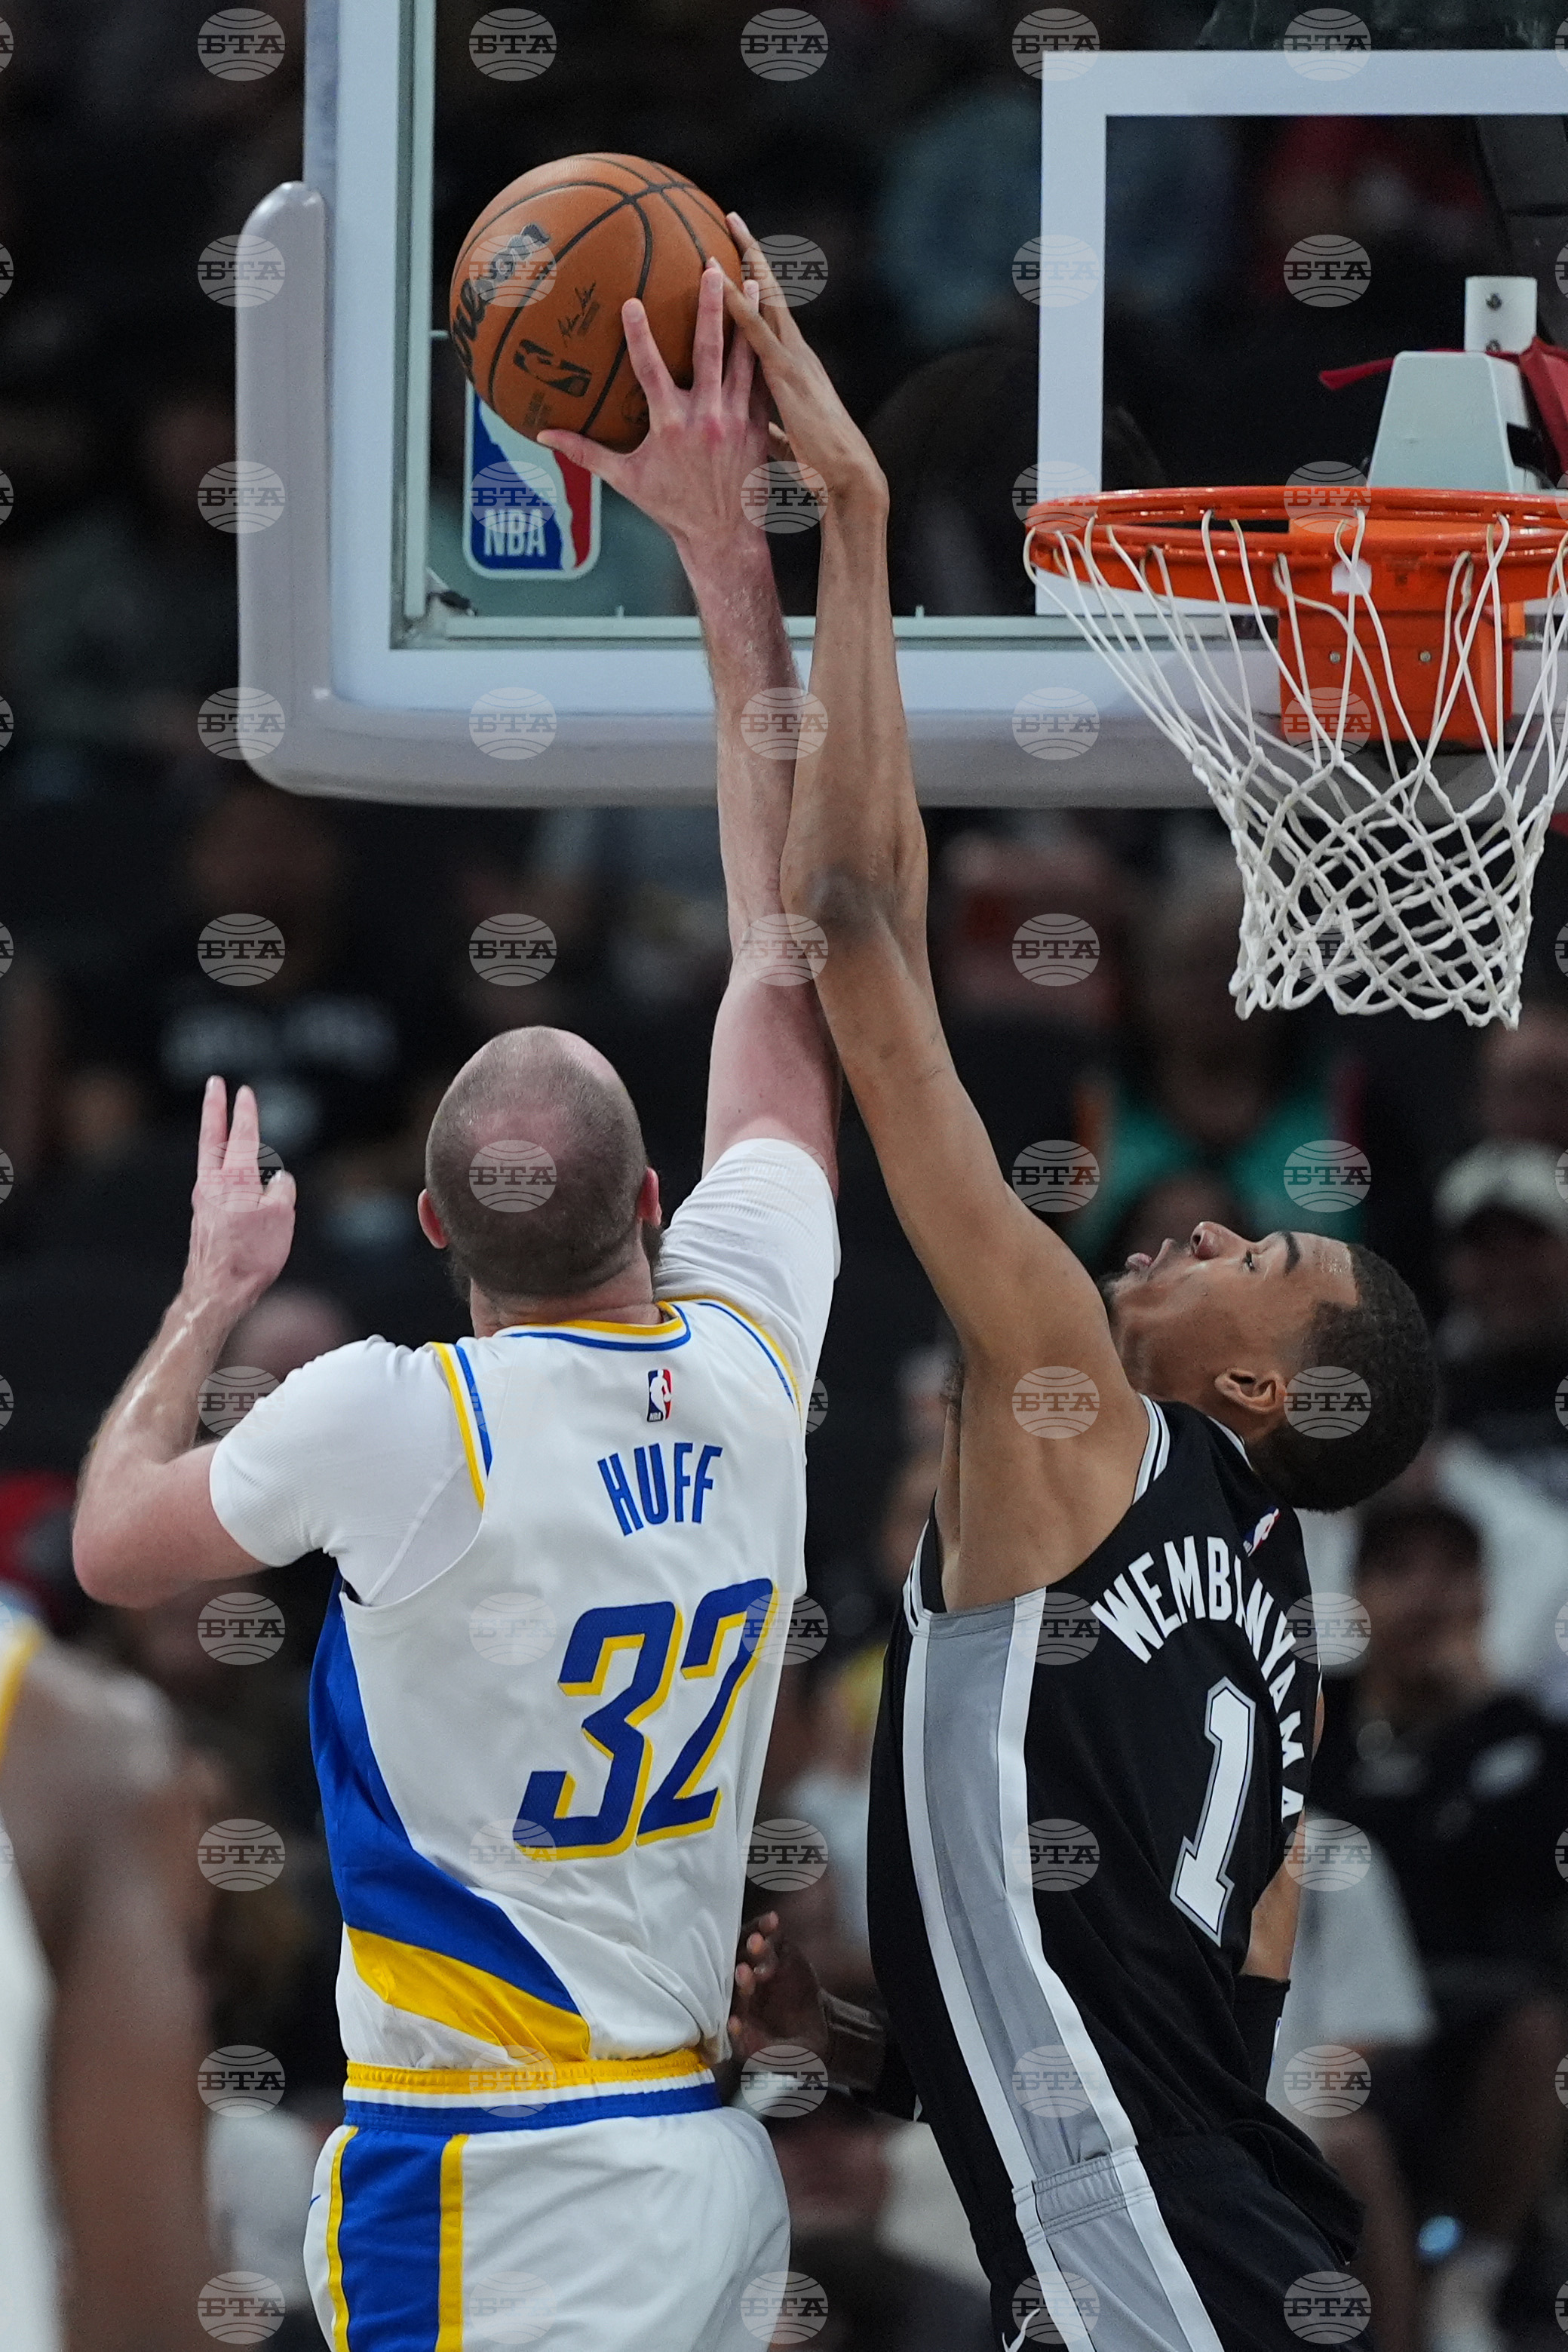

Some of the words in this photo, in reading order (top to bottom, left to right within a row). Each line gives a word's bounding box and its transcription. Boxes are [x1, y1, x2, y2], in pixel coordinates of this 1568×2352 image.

[483, 508, 547, 557] NBA
[597, 1442, 723, 1537] HUFF
[512, 1577, 780, 1862] 32
[1169, 1676, 1257, 1948] 1
